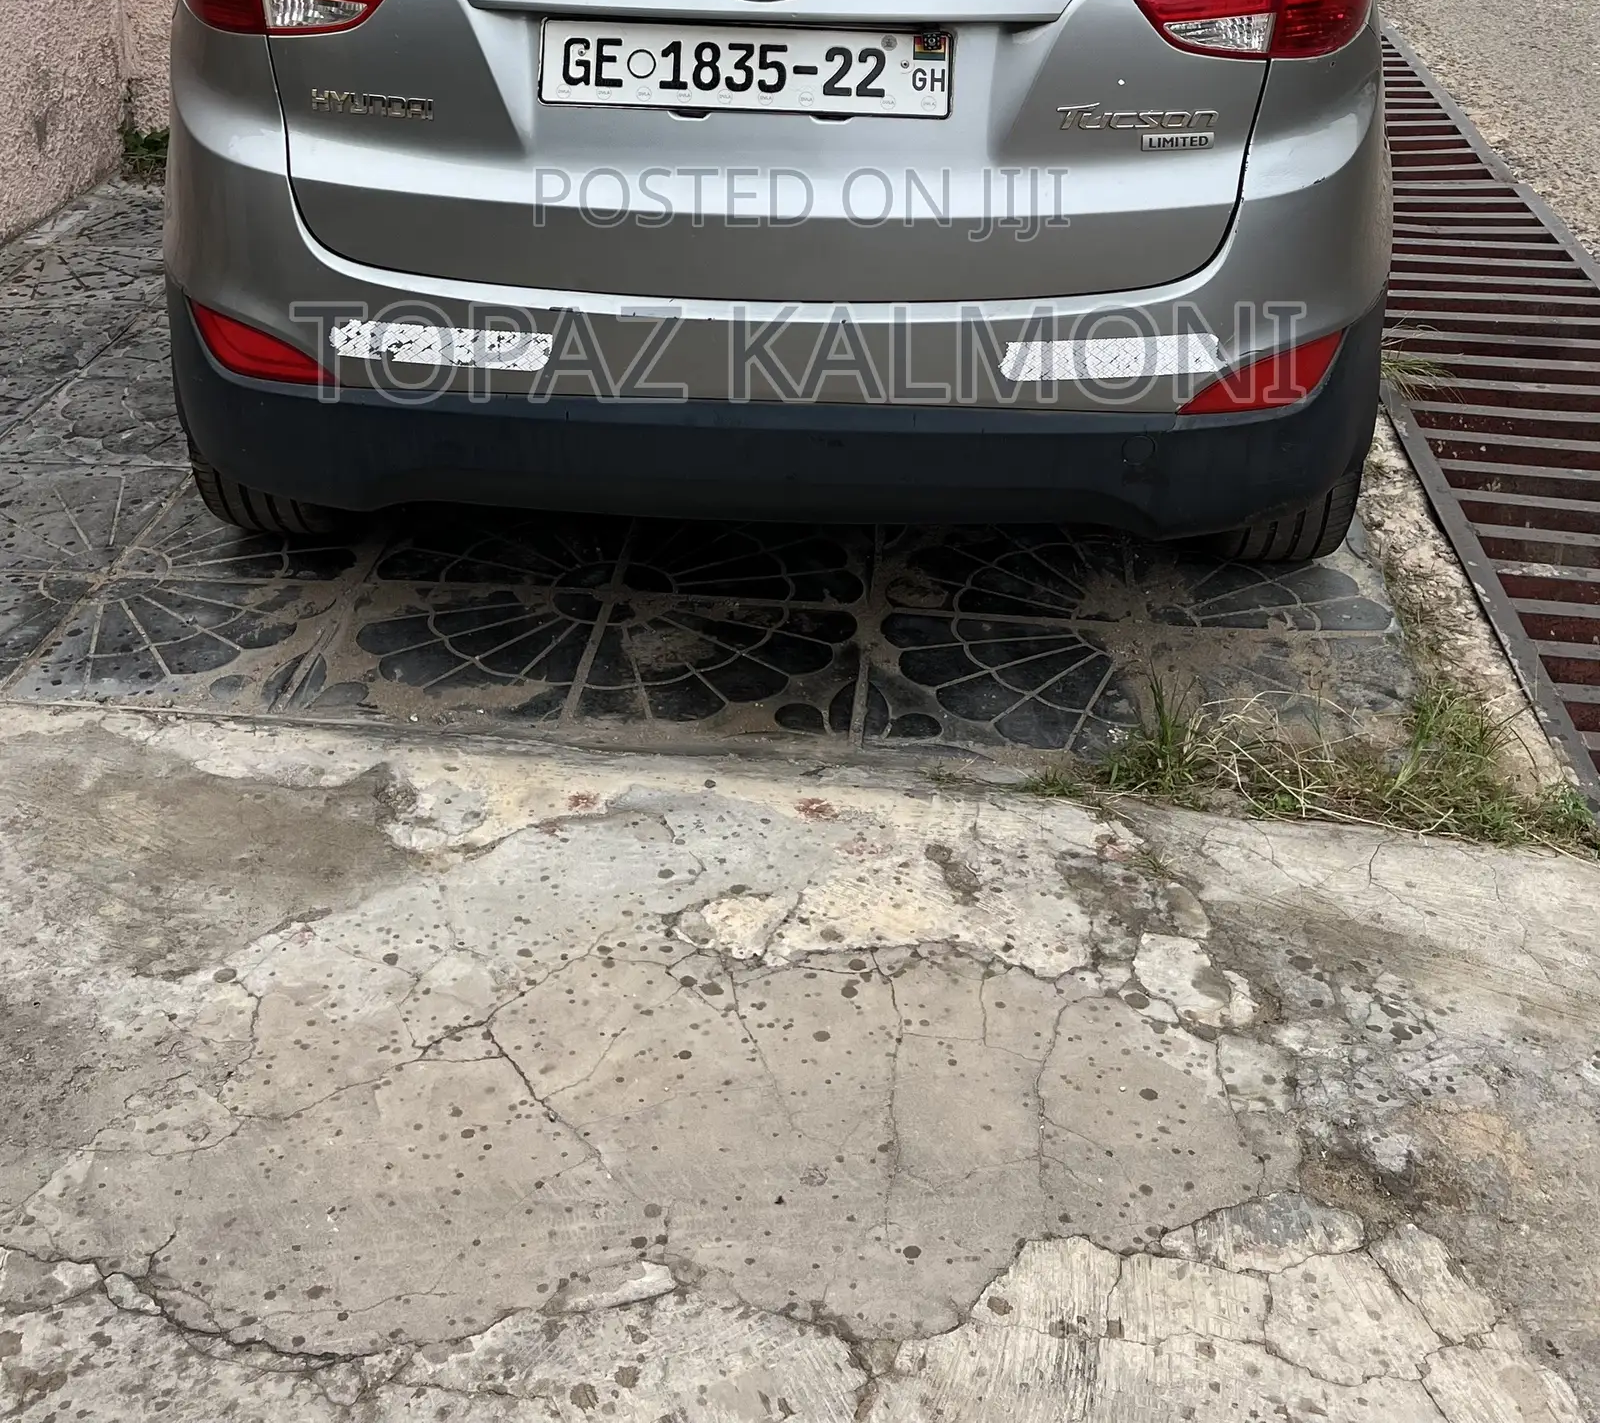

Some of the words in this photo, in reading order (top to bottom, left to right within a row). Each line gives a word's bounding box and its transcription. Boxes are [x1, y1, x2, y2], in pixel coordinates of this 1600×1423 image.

[561, 37, 623, 88] GE
[659, 41, 886, 98] 1835-22
[911, 68, 945, 93] GH
[311, 88, 434, 121] HYUNDAI
[1056, 102, 1219, 130] Tucson
[1149, 135, 1209, 148] LIMITED
